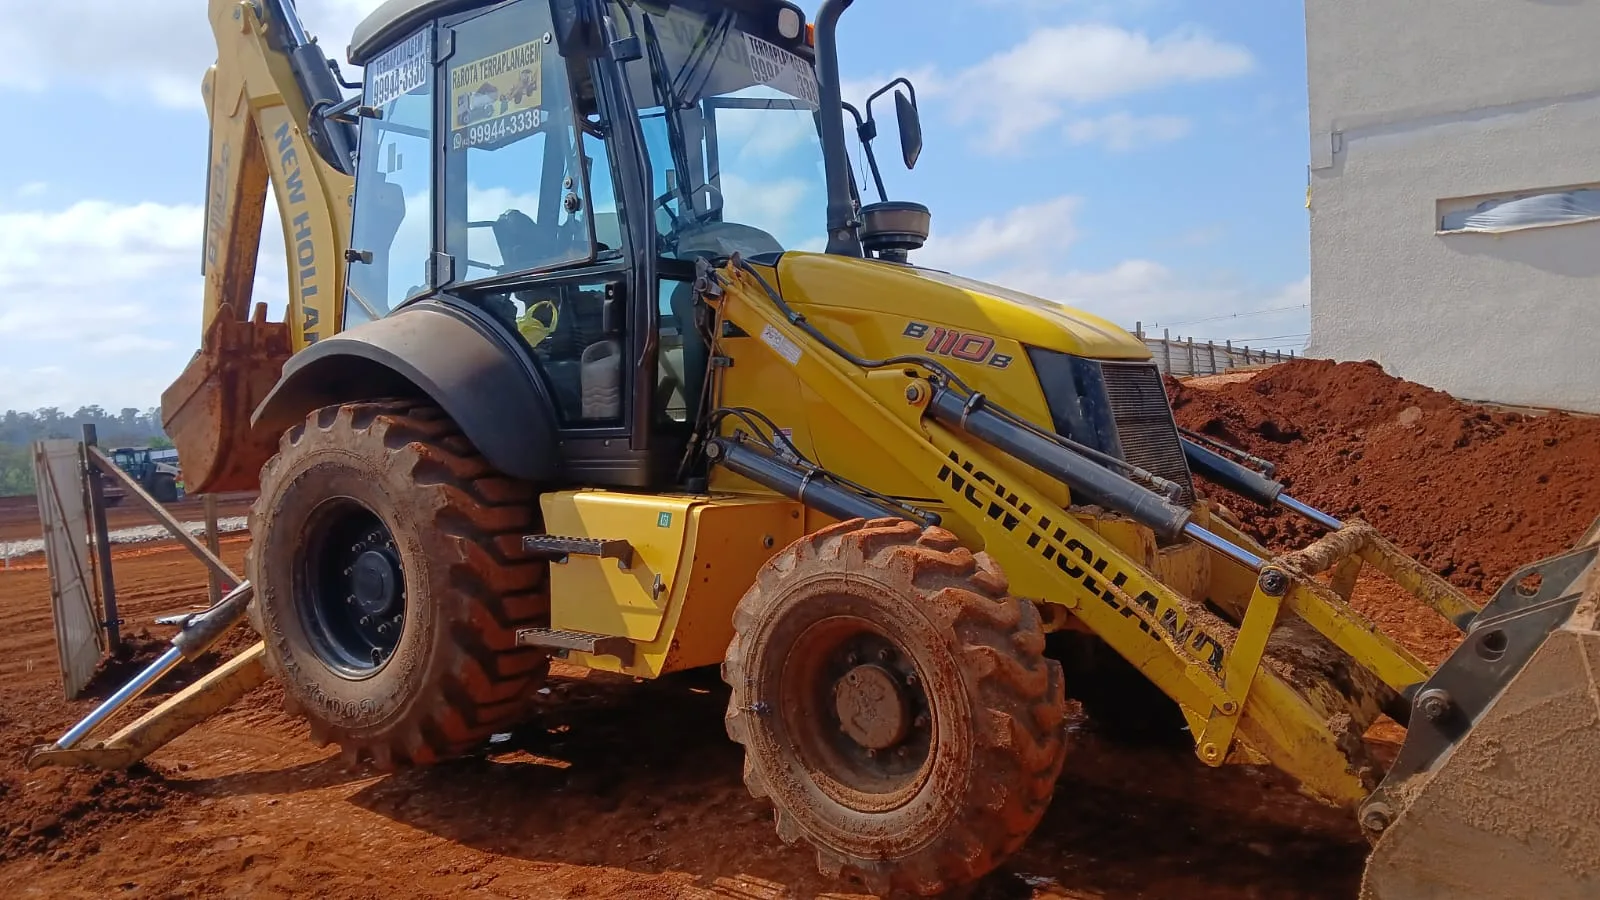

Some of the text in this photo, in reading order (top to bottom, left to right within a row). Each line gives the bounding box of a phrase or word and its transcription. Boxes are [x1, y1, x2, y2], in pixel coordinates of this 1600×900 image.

[480, 41, 541, 80] TERRAPLANAGEM
[470, 109, 540, 145] 99944-3338
[273, 121, 306, 205] NEW
